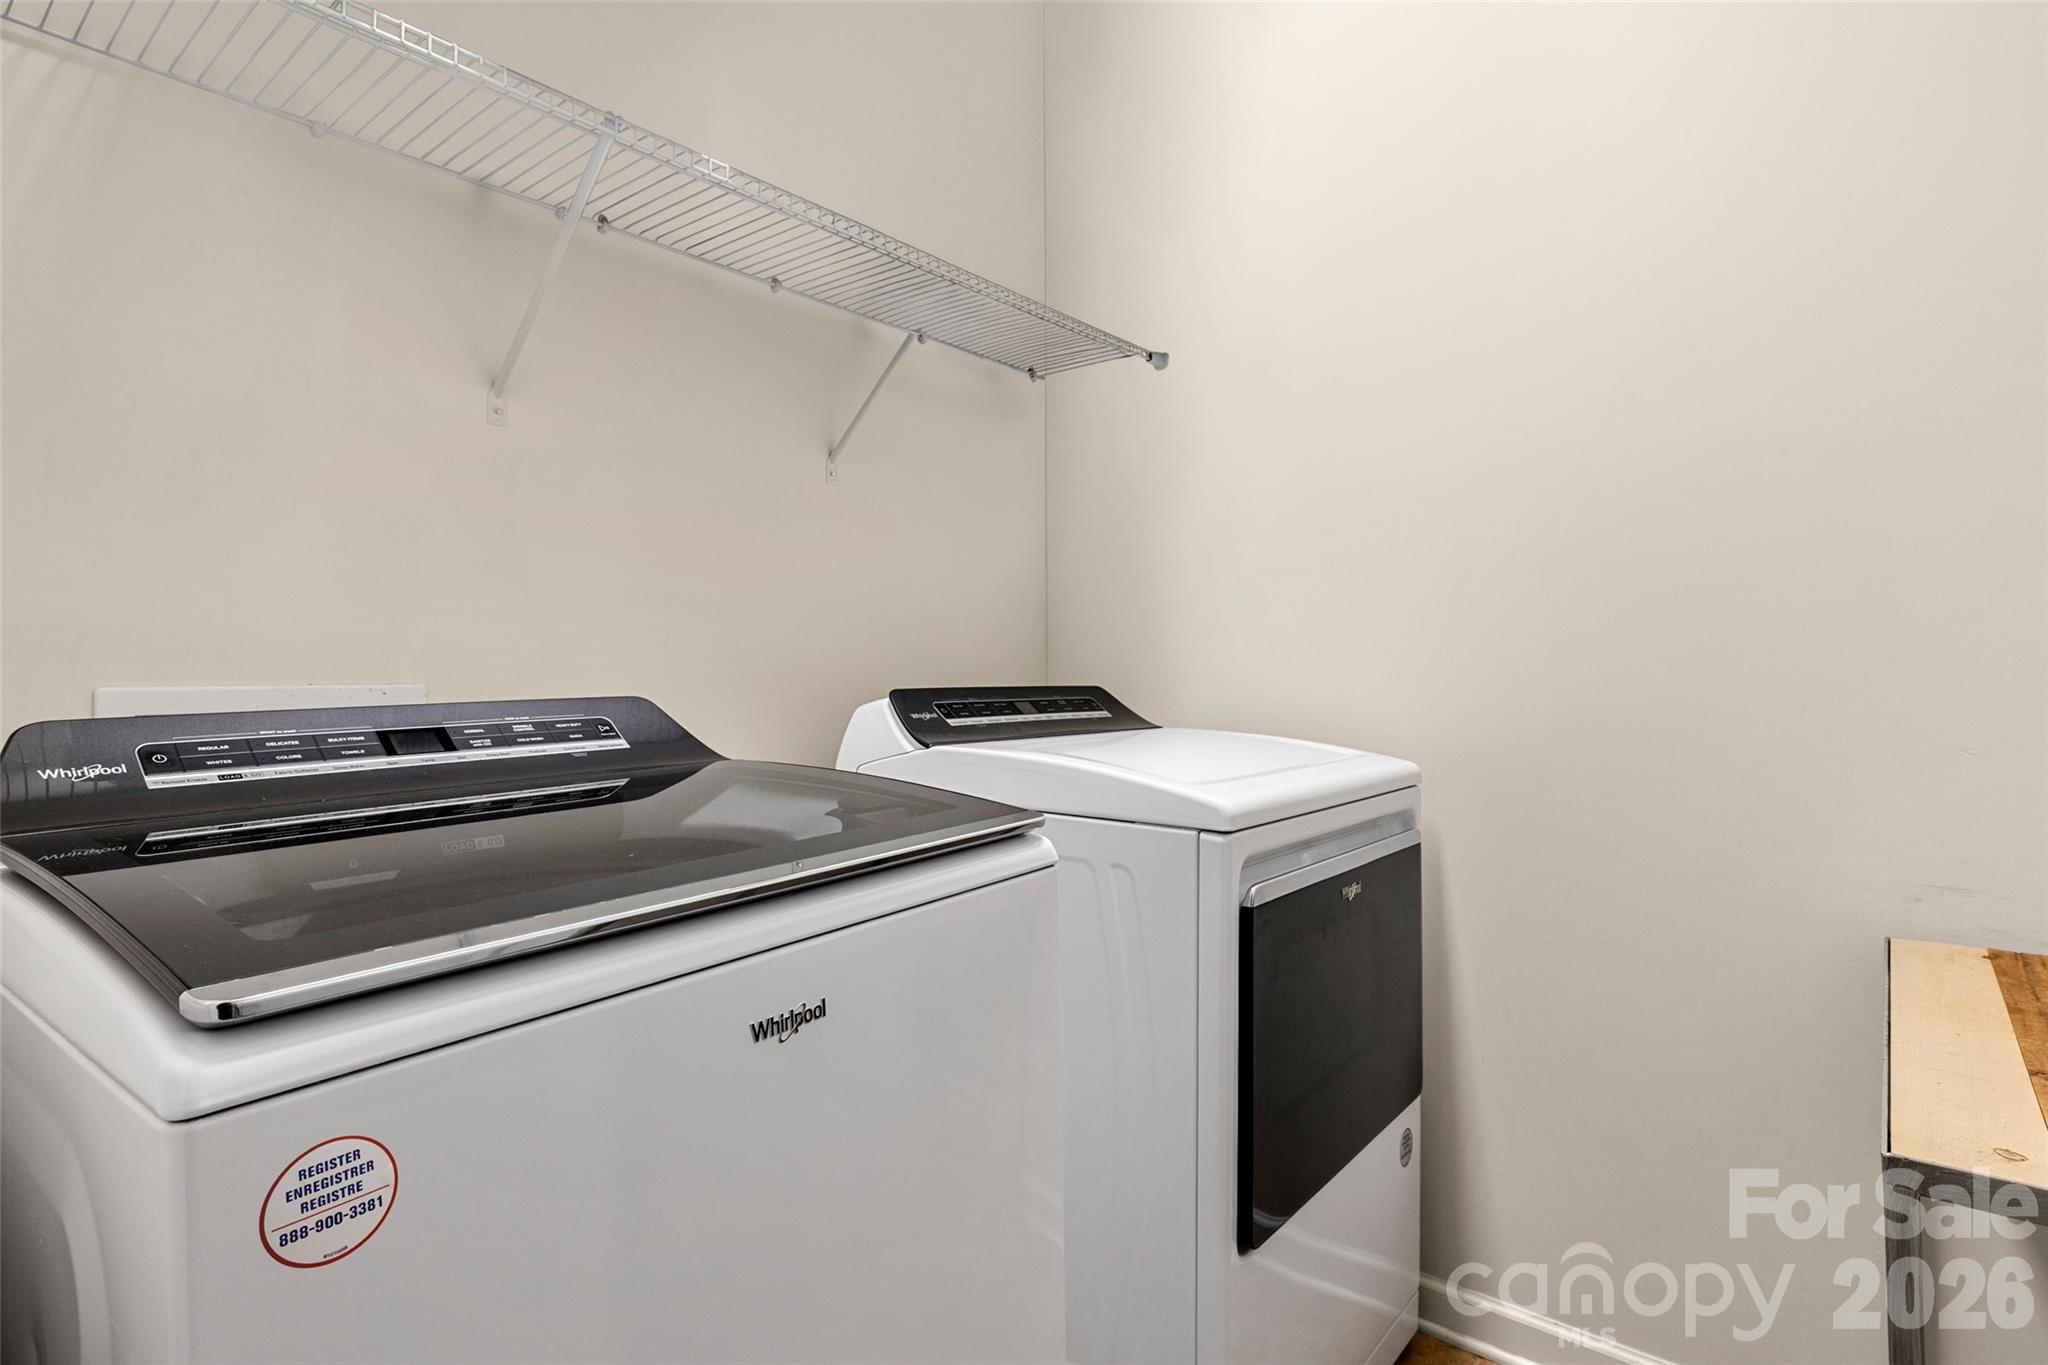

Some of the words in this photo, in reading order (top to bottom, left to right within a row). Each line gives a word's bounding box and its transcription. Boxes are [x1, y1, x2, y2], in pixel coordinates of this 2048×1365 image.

[37, 764, 127, 782] Whirlpool
[444, 841, 474, 853] LOAD
[749, 997, 827, 1043] Whirlpool
[286, 1160, 374, 1203] ENREGISTRER
[298, 1149, 361, 1182] REGISTER
[300, 1180, 363, 1214] REGISTRE
[279, 1195, 383, 1247] 888-900-3381
